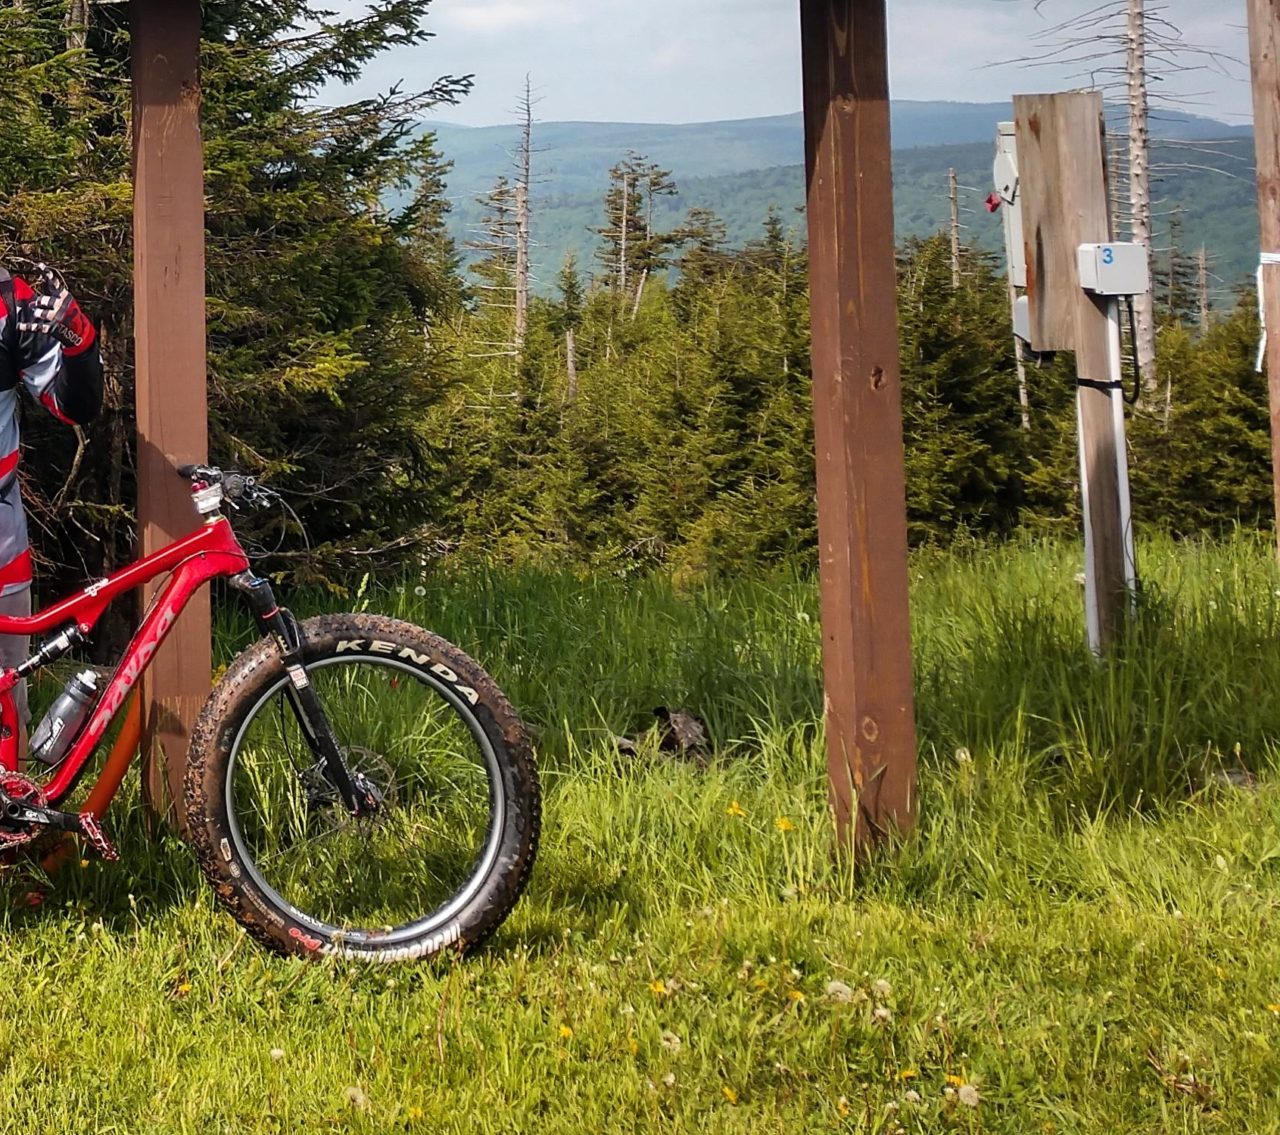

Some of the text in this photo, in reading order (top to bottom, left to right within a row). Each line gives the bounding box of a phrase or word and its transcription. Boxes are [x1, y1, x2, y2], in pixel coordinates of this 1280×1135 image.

[1103, 248, 1113, 264] 3
[59, 324, 84, 347] TASCO
[336, 639, 480, 706] KENDA
